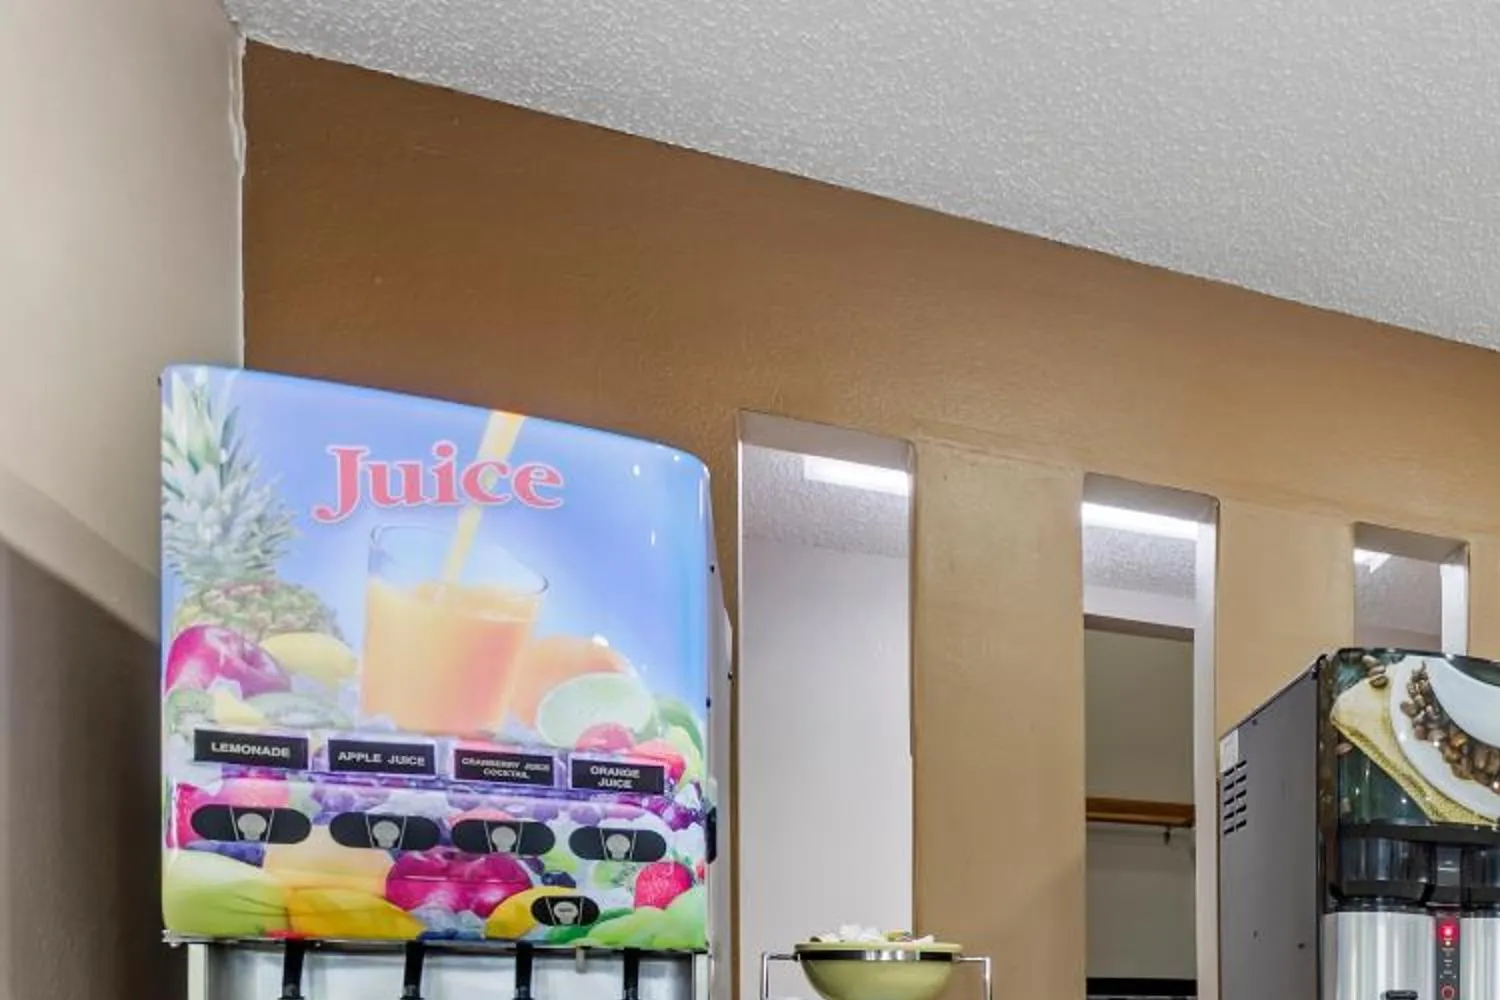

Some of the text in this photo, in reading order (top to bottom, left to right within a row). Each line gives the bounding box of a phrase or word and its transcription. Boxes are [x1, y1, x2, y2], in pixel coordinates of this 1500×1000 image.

[313, 440, 565, 523] Juice
[211, 740, 291, 759] LEMONADE
[338, 751, 426, 767] APPLE JUICE
[483, 767, 531, 780] COCKTAIL
[524, 762, 550, 772] JUICE
[590, 765, 641, 779] ORANGE
[597, 777, 633, 789] JUICE
